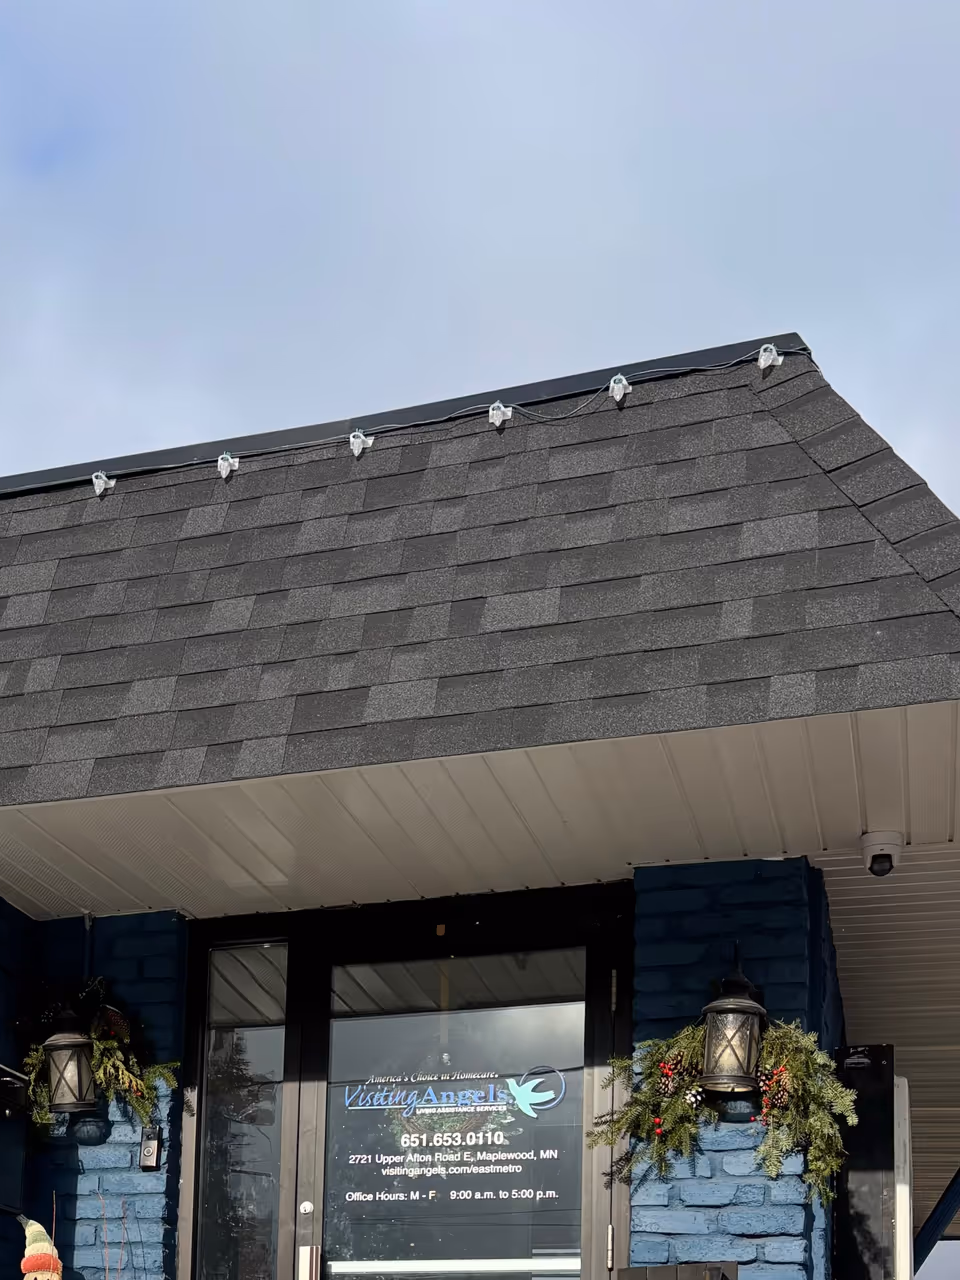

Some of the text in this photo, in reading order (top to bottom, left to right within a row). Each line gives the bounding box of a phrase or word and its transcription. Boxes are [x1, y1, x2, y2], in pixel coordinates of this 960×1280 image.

[366, 1072, 408, 1084] America's
[410, 1072, 438, 1083] Choice
[441, 1072, 450, 1080] in
[344, 1084, 422, 1117] Visiting
[401, 1131, 504, 1147] 651.653.0110
[349, 1149, 558, 1166] 2721 Upper Afton Road E, Maplewood, MN
[381, 1164, 522, 1177] visitingangels.com/eastmetro
[346, 1192, 374, 1202] Office
[376, 1191, 408, 1201] Hours:
[410, 1191, 420, 1200] M
[428, 1191, 436, 1200] F
[450, 1190, 471, 1200] 9:00
[474, 1191, 496, 1200] a.m.
[498, 1191, 509, 1200] to
[511, 1190, 534, 1199] 5:00
[536, 1190, 559, 1201] p.m.
